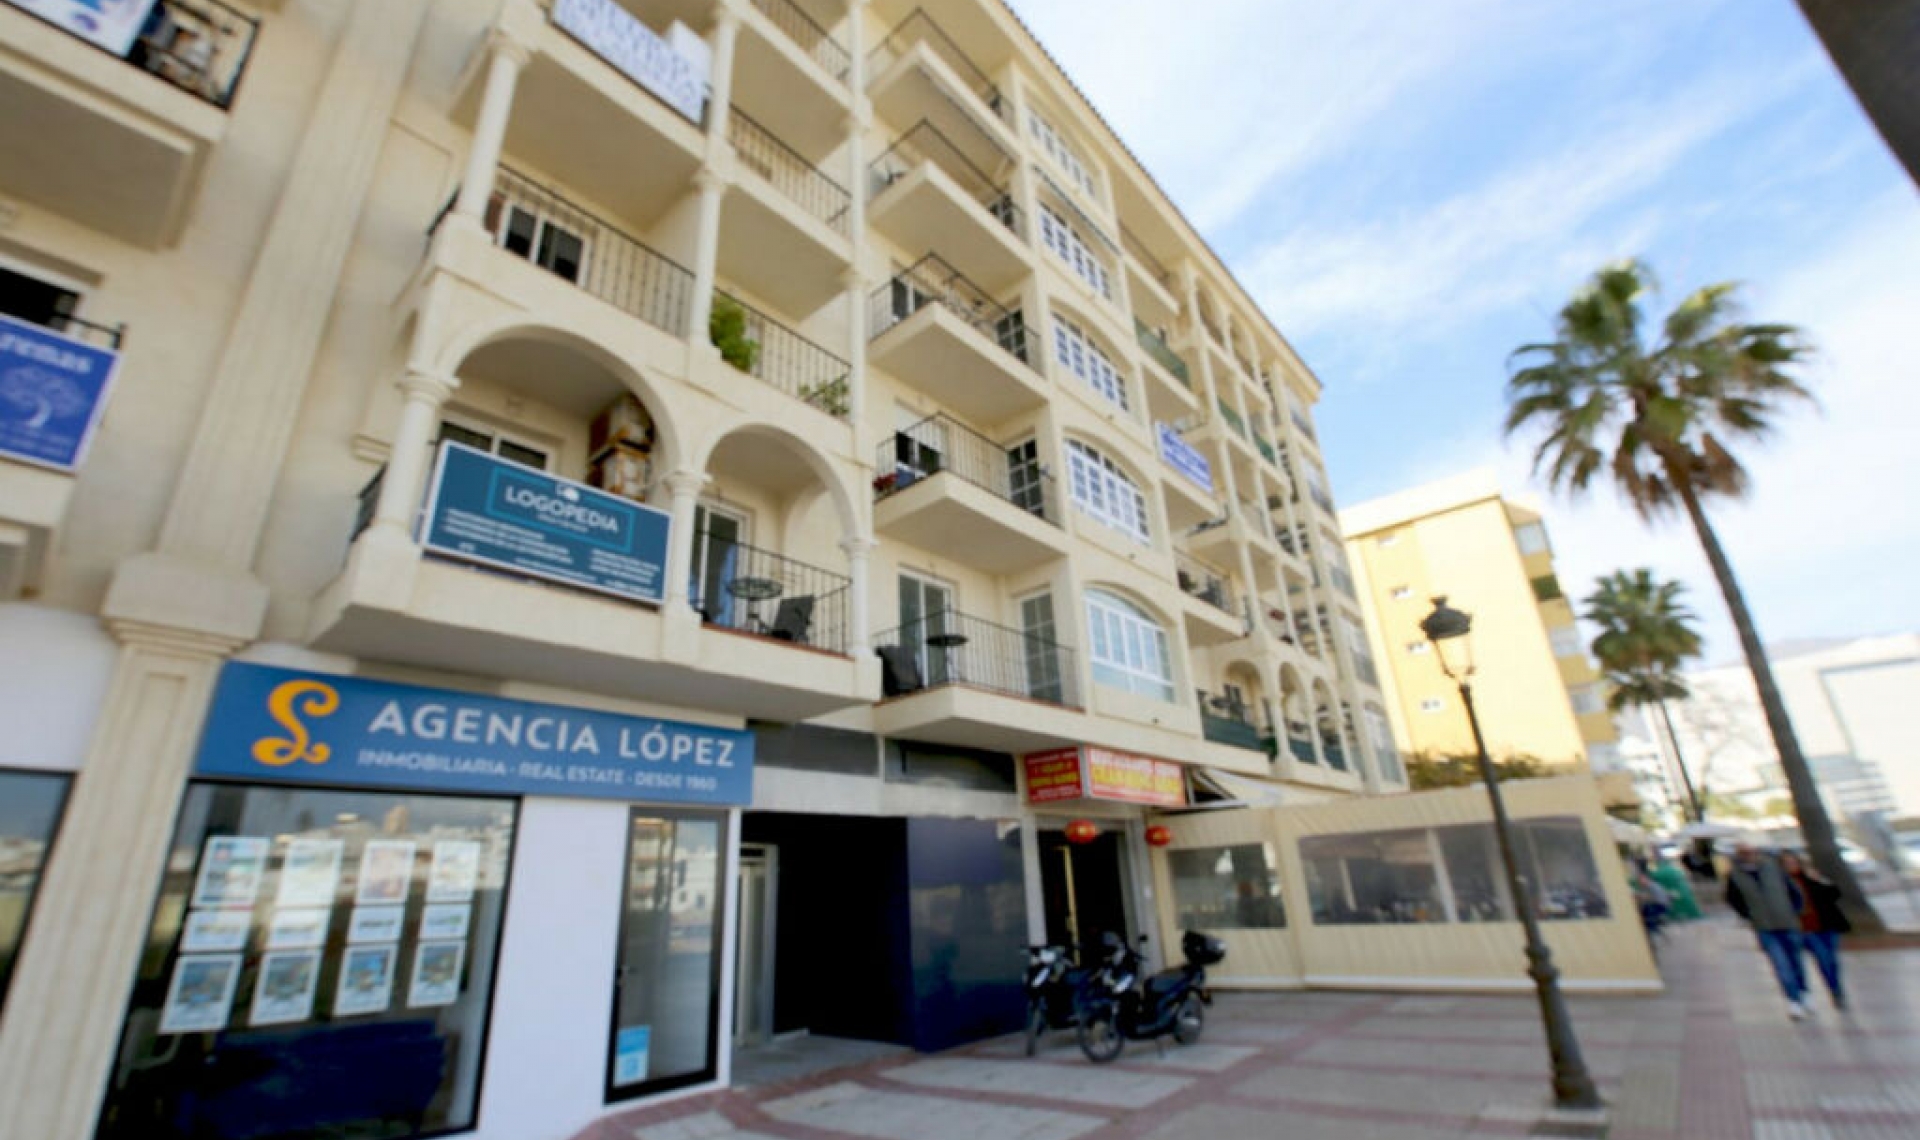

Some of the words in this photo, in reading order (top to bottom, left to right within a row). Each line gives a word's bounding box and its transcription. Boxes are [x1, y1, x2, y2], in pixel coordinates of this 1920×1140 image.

[505, 485, 619, 532] LOGOPEDIA
[368, 701, 599, 755] AGENCIA
[618, 723, 736, 767] LÓPEZ
[358, 749, 507, 775] INMOBILIARIA
[518, 761, 563, 781] REAL
[567, 765, 624, 784] ESTATE
[634, 771, 682, 788] DESDE
